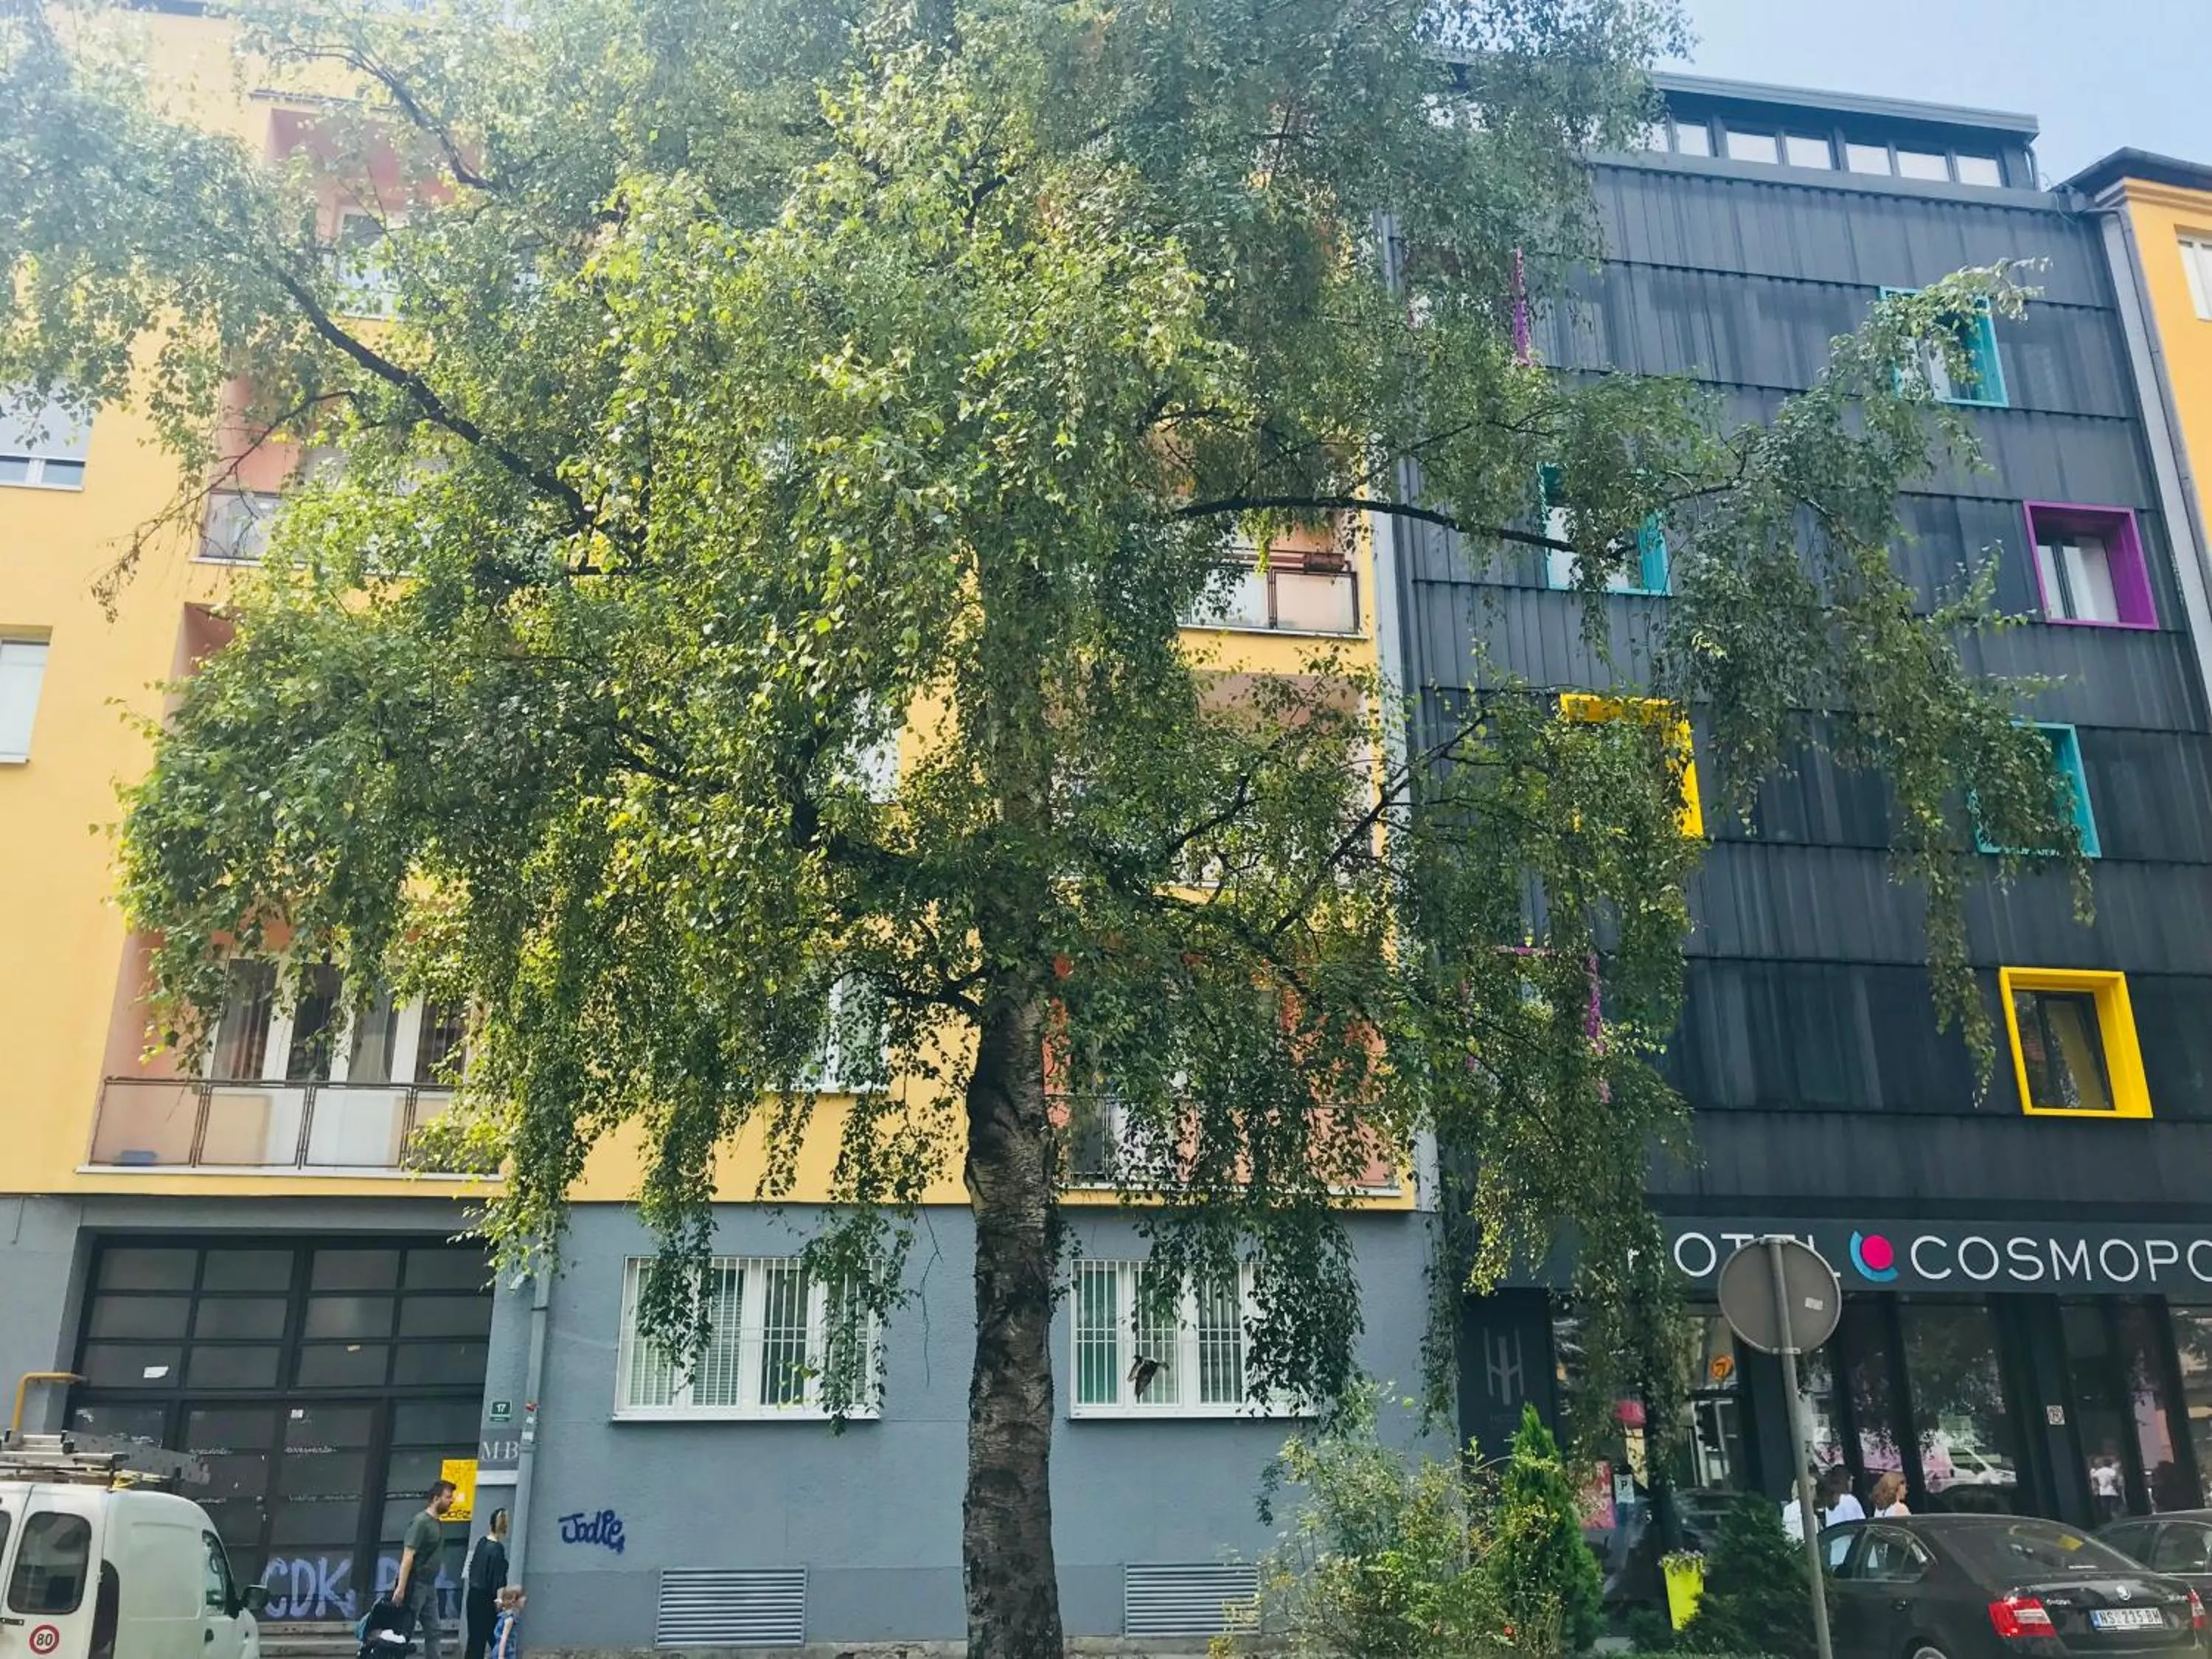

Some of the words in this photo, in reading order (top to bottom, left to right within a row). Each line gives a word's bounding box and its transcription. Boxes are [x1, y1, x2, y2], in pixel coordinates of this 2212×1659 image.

[1910, 1235, 2212, 1283] COSMOPO
[495, 1403, 507, 1413] 17
[36, 1633, 53, 1646] 80
